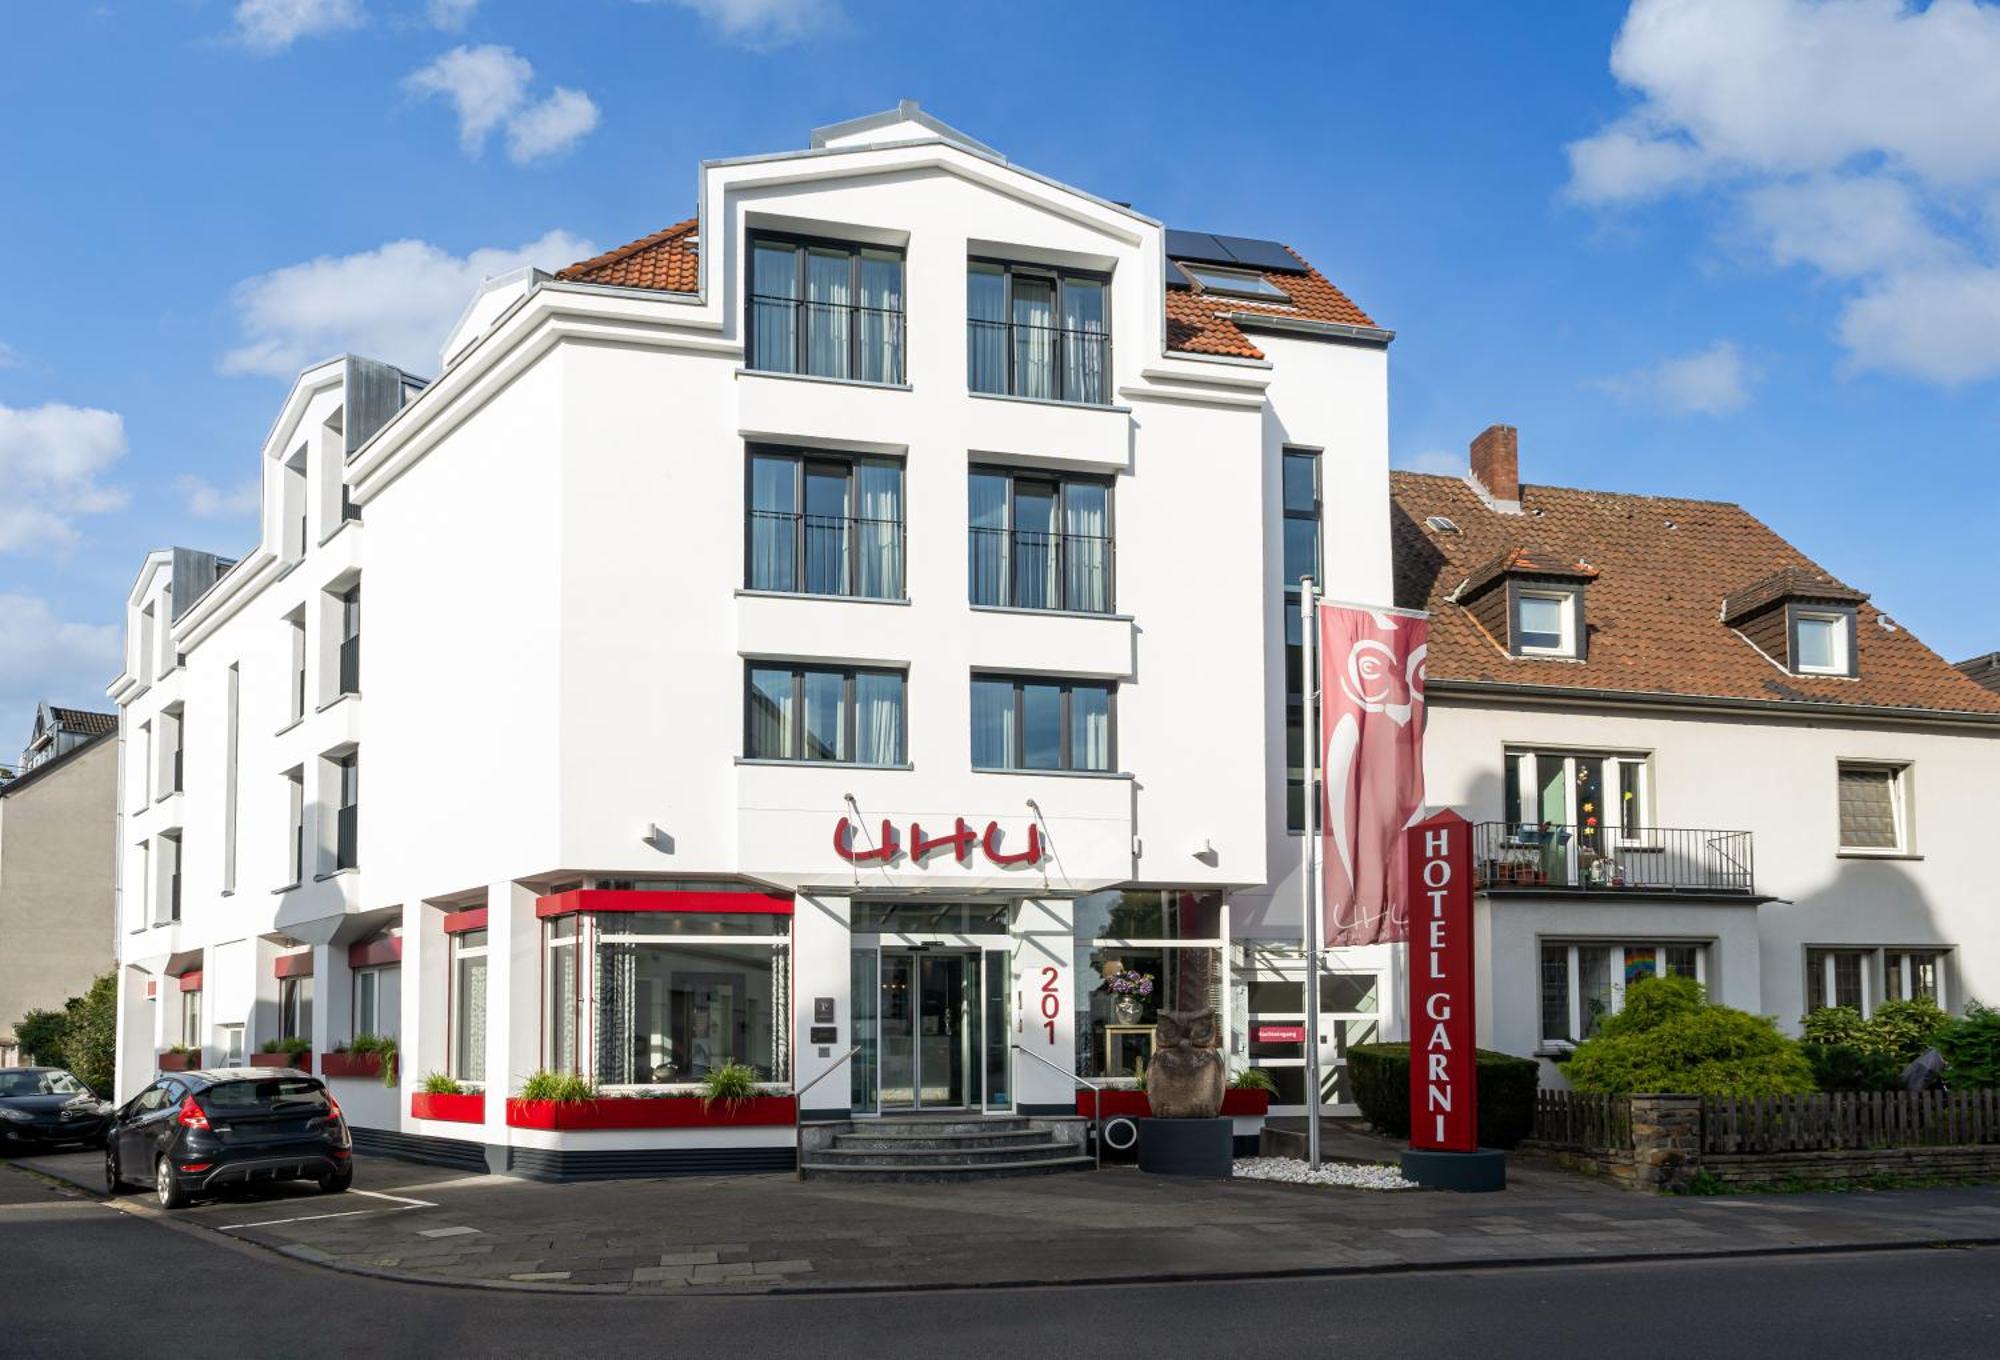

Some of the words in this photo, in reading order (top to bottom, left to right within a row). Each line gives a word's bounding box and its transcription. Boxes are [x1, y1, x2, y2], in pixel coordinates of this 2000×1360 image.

[833, 816, 1046, 865] UHU
[1423, 828, 1451, 979] HOTEL
[1041, 966, 1059, 1046] 201
[1426, 992, 1452, 1143] GARNI
